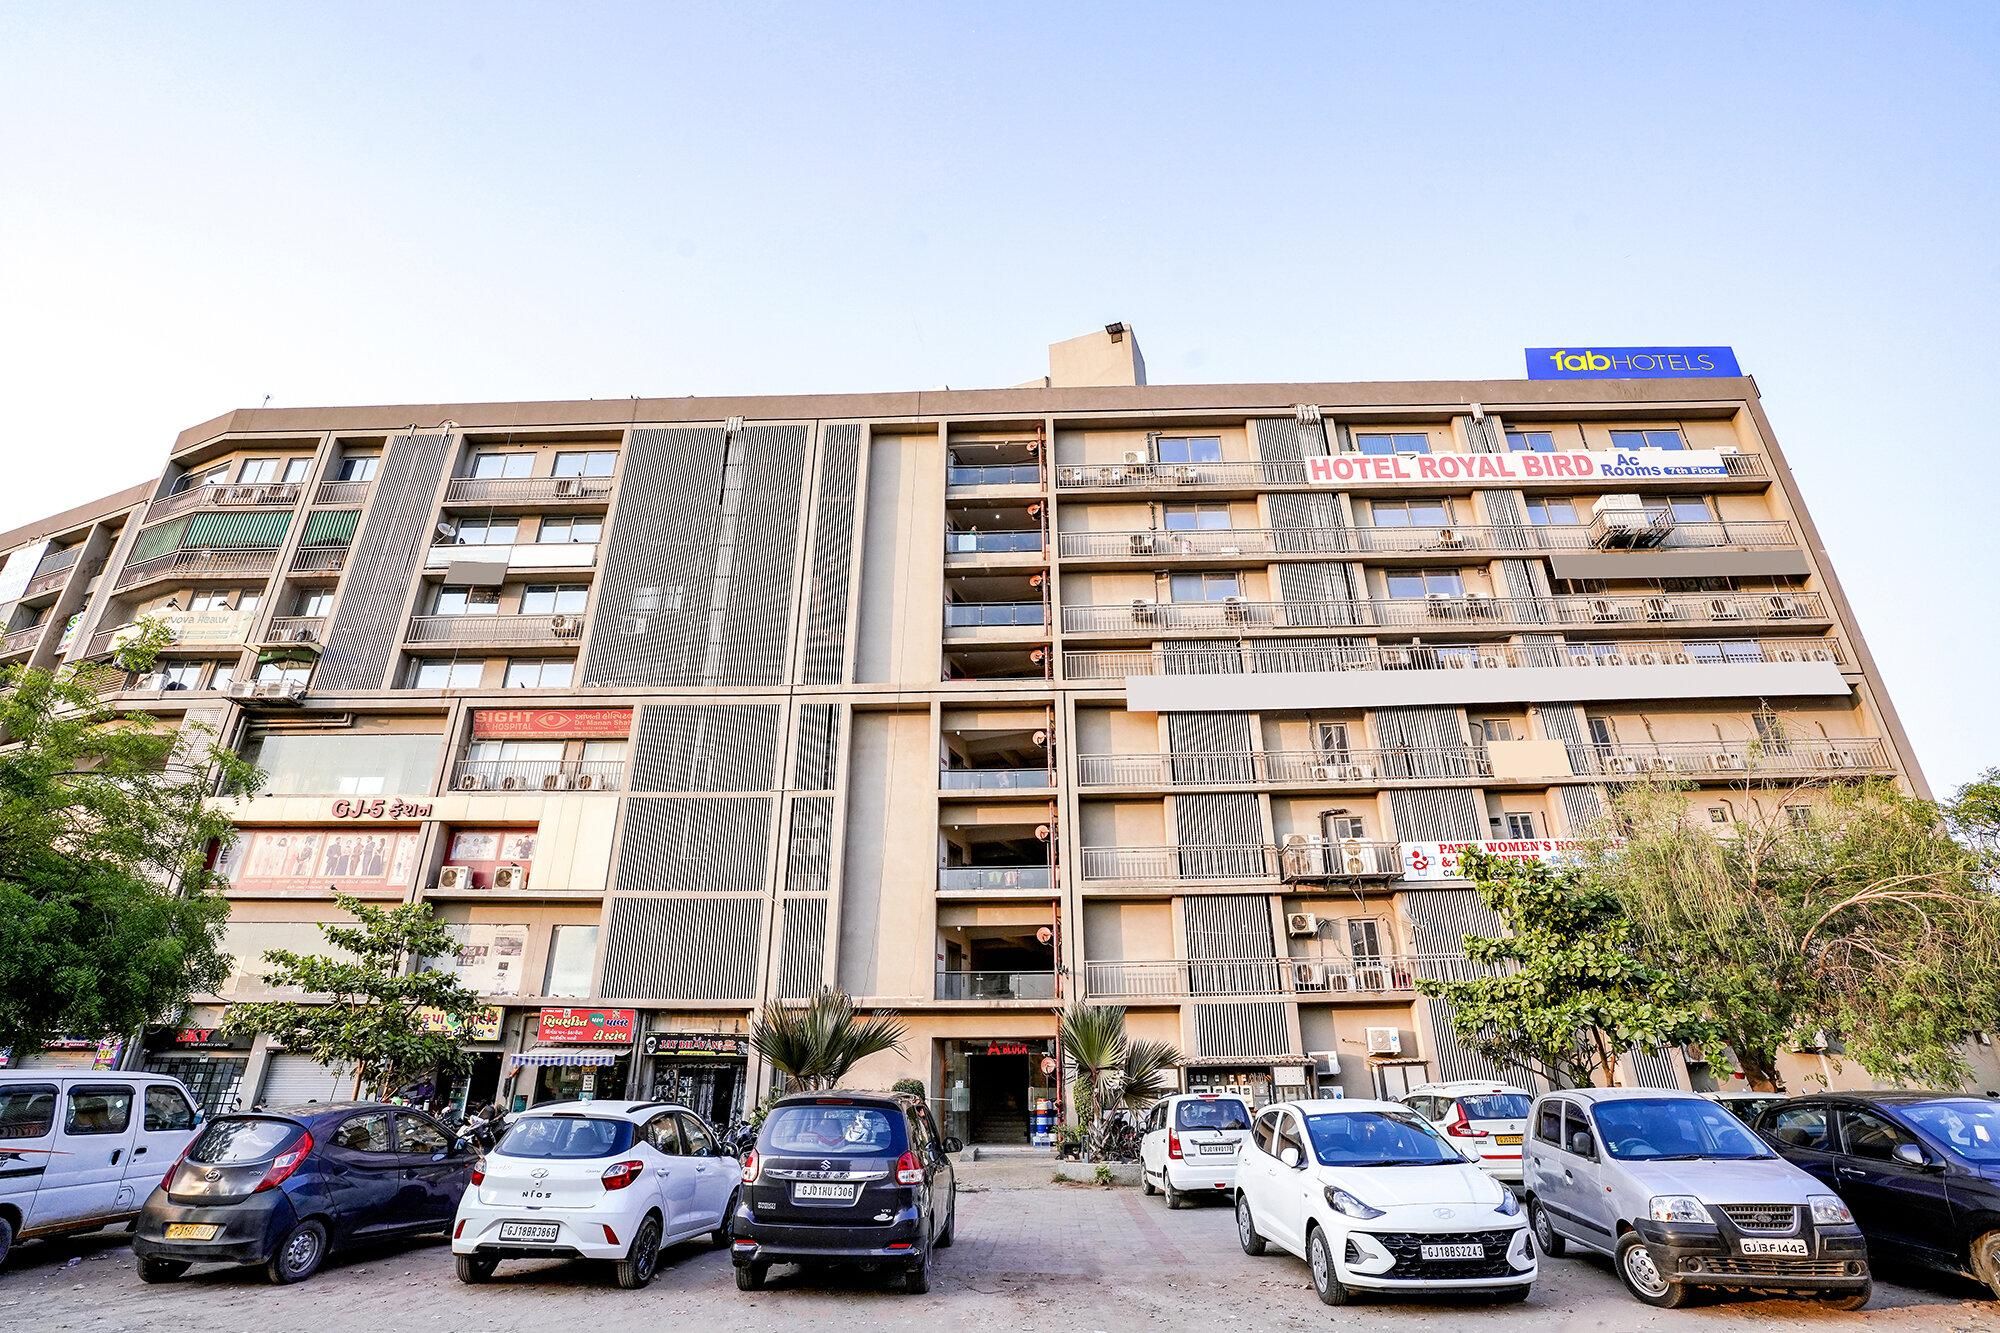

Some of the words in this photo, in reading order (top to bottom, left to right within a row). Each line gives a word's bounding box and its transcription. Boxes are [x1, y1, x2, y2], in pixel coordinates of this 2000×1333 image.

[1616, 453, 1640, 466] Ac
[1311, 457, 1411, 480] HOTEL
[1420, 456, 1516, 479] ROYAL
[1526, 455, 1594, 477] BIRD
[1601, 463, 1662, 477] Rooms
[1668, 467, 1689, 475] 7th
[1691, 466, 1721, 475] Floor
[475, 711, 534, 723] SIGHT
[492, 723, 533, 731] HOSPITAL
[331, 799, 385, 818] GJ-5
[1485, 840, 1552, 853] WOMEN'S
[507, 1225, 557, 1238] GJ18BR3868
[1427, 1245, 1483, 1258] GJ18BS2243
